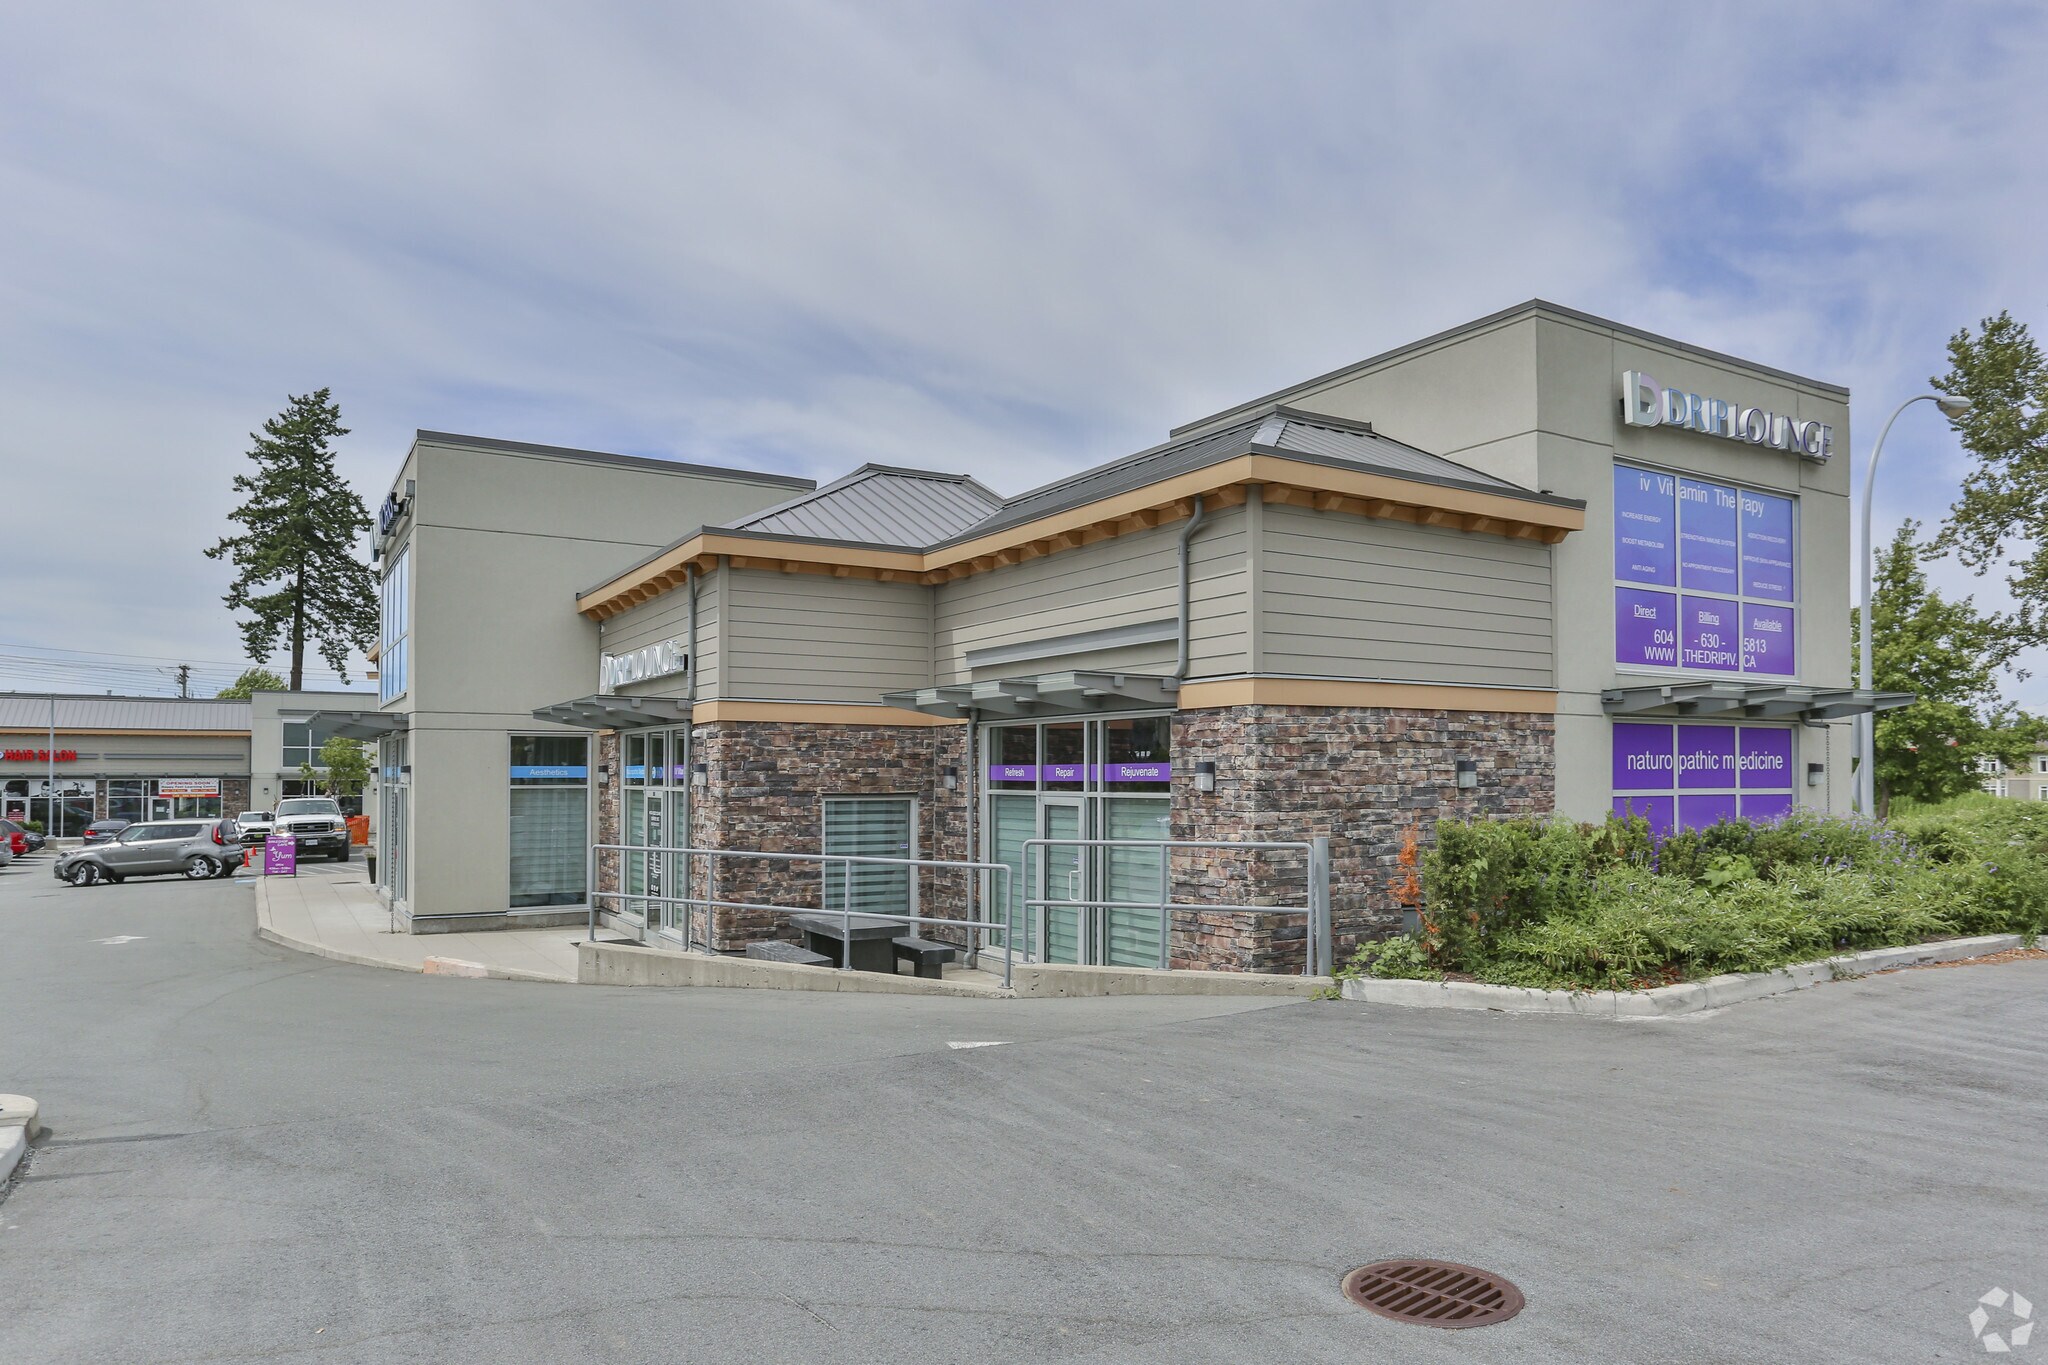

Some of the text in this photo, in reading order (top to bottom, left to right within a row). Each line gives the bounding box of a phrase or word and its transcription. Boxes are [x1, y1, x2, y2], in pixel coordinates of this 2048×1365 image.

[1663, 388, 1728, 434] DRIP
[1731, 403, 1833, 459] LOUNGE
[1639, 473, 1651, 492] iv
[1622, 511, 1662, 523] INCREASE ENERGY
[1634, 604, 1782, 632] Direct Billing Available
[1654, 629, 1674, 645] 604
[1700, 633, 1720, 649] 630
[1743, 637, 1767, 653] 5813
[4, 749, 35, 762] HAIR
[1627, 750, 1784, 775] naturopathic medicine
[529, 768, 568, 777] Aesthetics
[1005, 767, 1025, 777] Refresh
[1055, 767, 1075, 779] Repair
[1121, 766, 1159, 779] Rejuvenate
[271, 850, 292, 862] Yum
